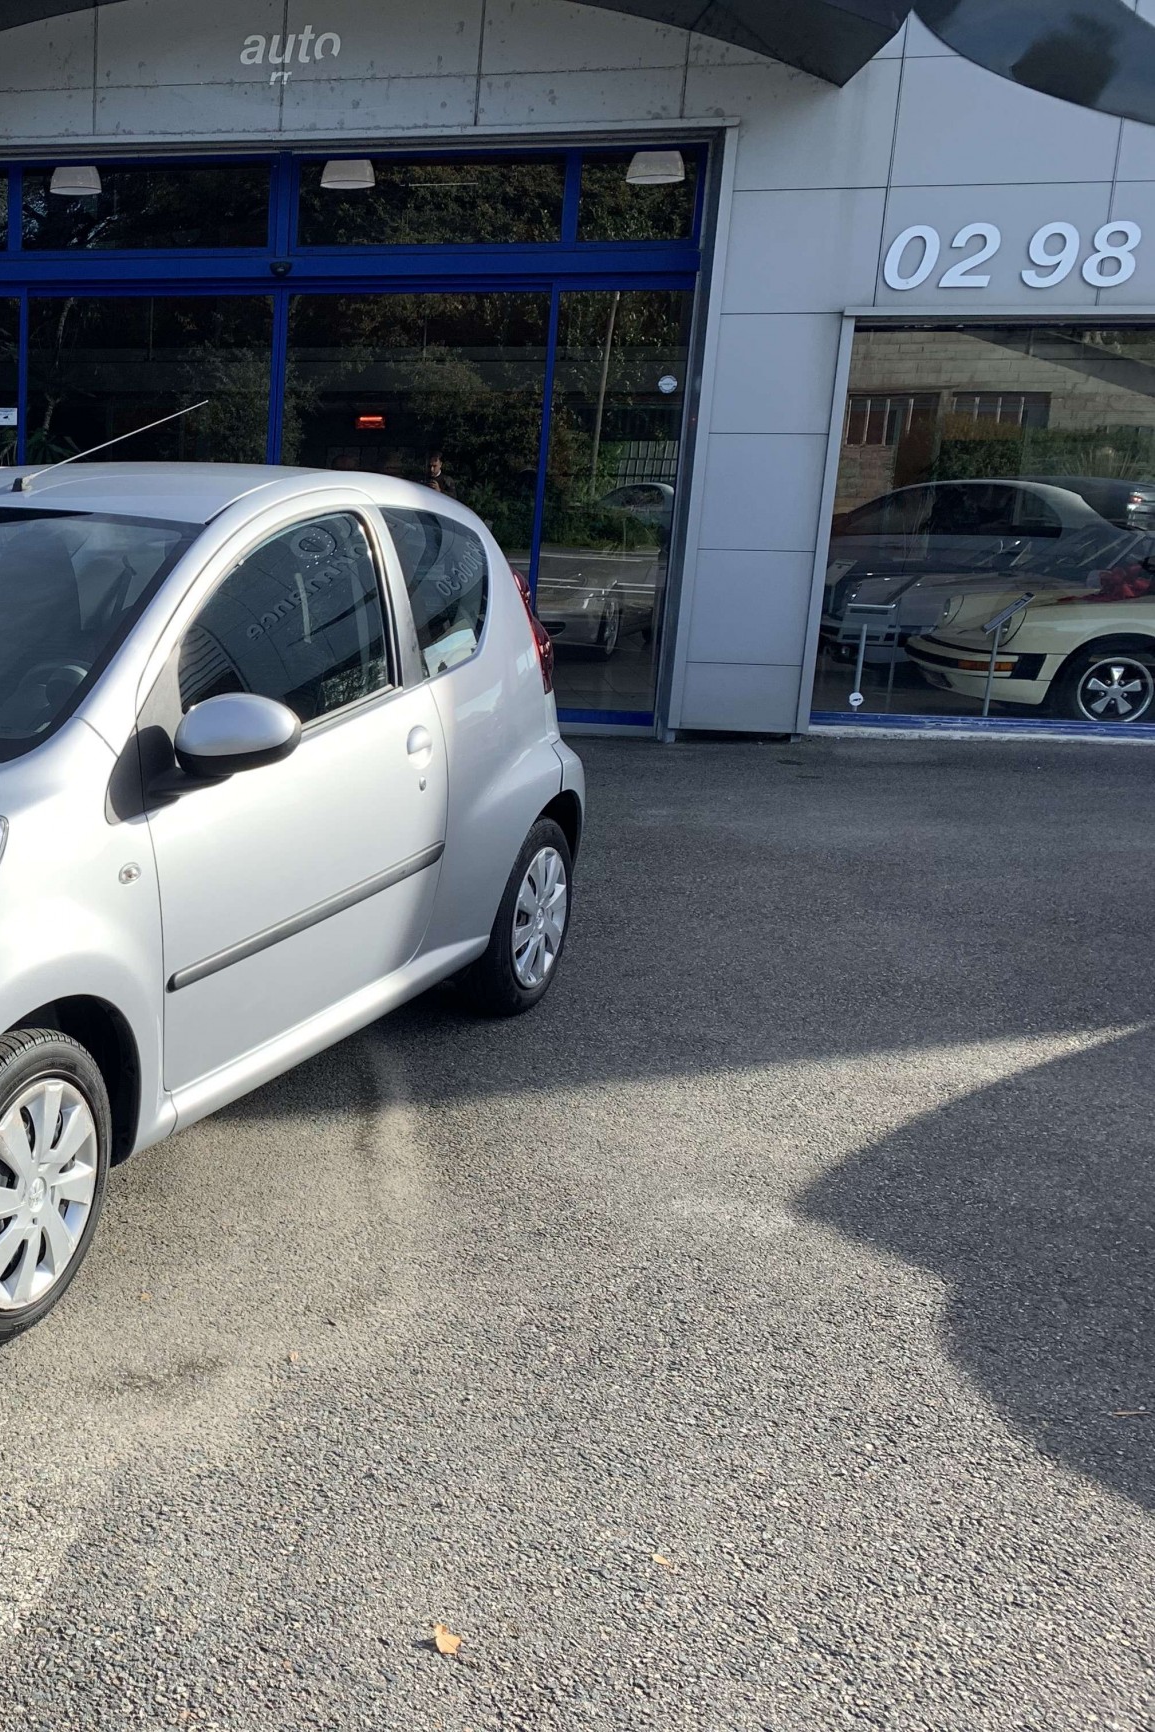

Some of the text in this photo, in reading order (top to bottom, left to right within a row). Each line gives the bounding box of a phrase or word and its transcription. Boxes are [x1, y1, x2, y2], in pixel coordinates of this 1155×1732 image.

[240, 25, 341, 64] auto
[884, 220, 1142, 290] 02 98
